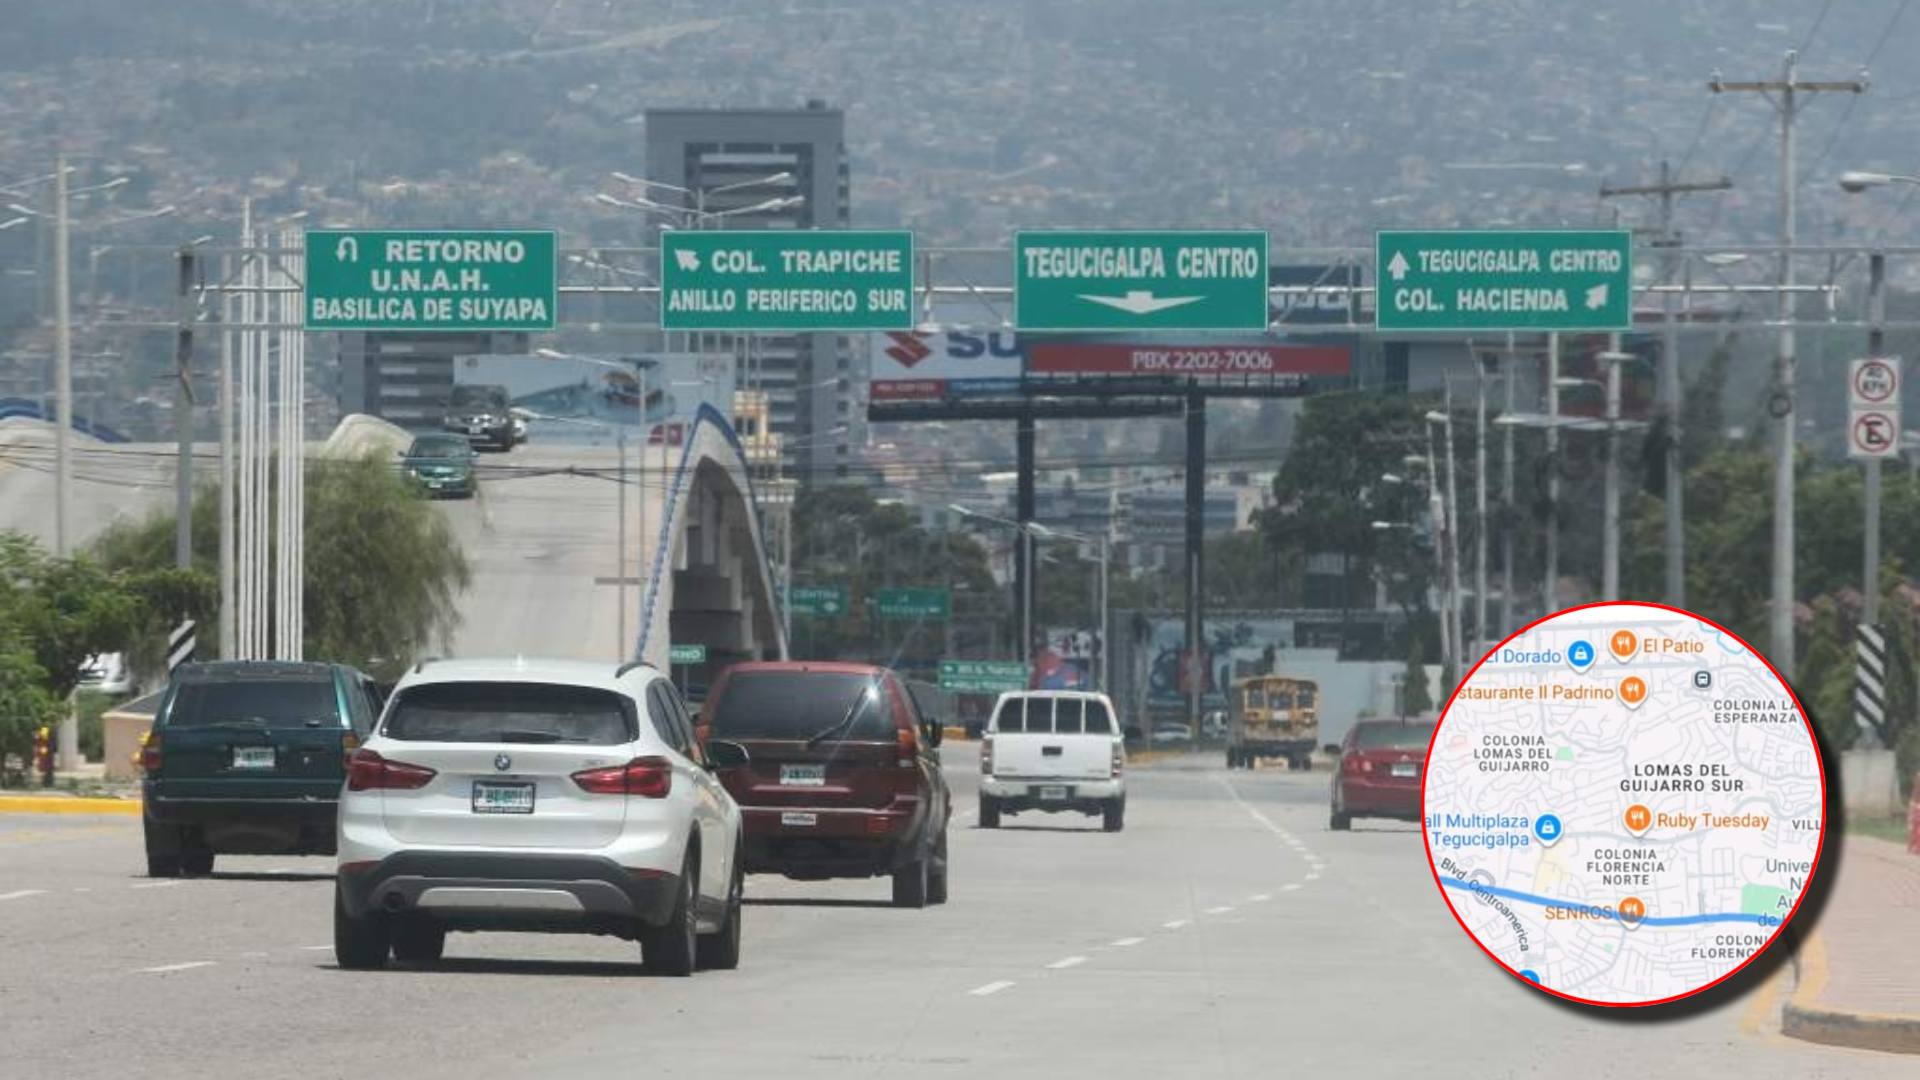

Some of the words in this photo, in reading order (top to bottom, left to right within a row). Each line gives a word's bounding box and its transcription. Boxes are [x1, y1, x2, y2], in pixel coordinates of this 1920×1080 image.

[386, 240, 525, 262] RETORNO
[711, 250, 766, 273] COL.
[780, 250, 901, 273] TRAPICHE
[1024, 247, 1166, 278] TEGUCIGALPA
[1177, 247, 1259, 278] CENTRO
[1418, 250, 1540, 273] TEGUCIGALPA
[1551, 250, 1622, 273] CENTRO
[371, 269, 490, 291] U.N.A.H.
[312, 298, 416, 320] BASILICA
[423, 299, 452, 320] DE
[459, 298, 547, 321] SUYAPA
[668, 289, 736, 311] ANILLO
[747, 289, 857, 312] PERIFERICO
[868, 289, 906, 311] SUR
[1394, 289, 1444, 311] COL.
[1457, 289, 1568, 311] HACIENDA
[1132, 352, 1170, 369] PBX
[1173, 352, 1273, 369] 2202-7006
